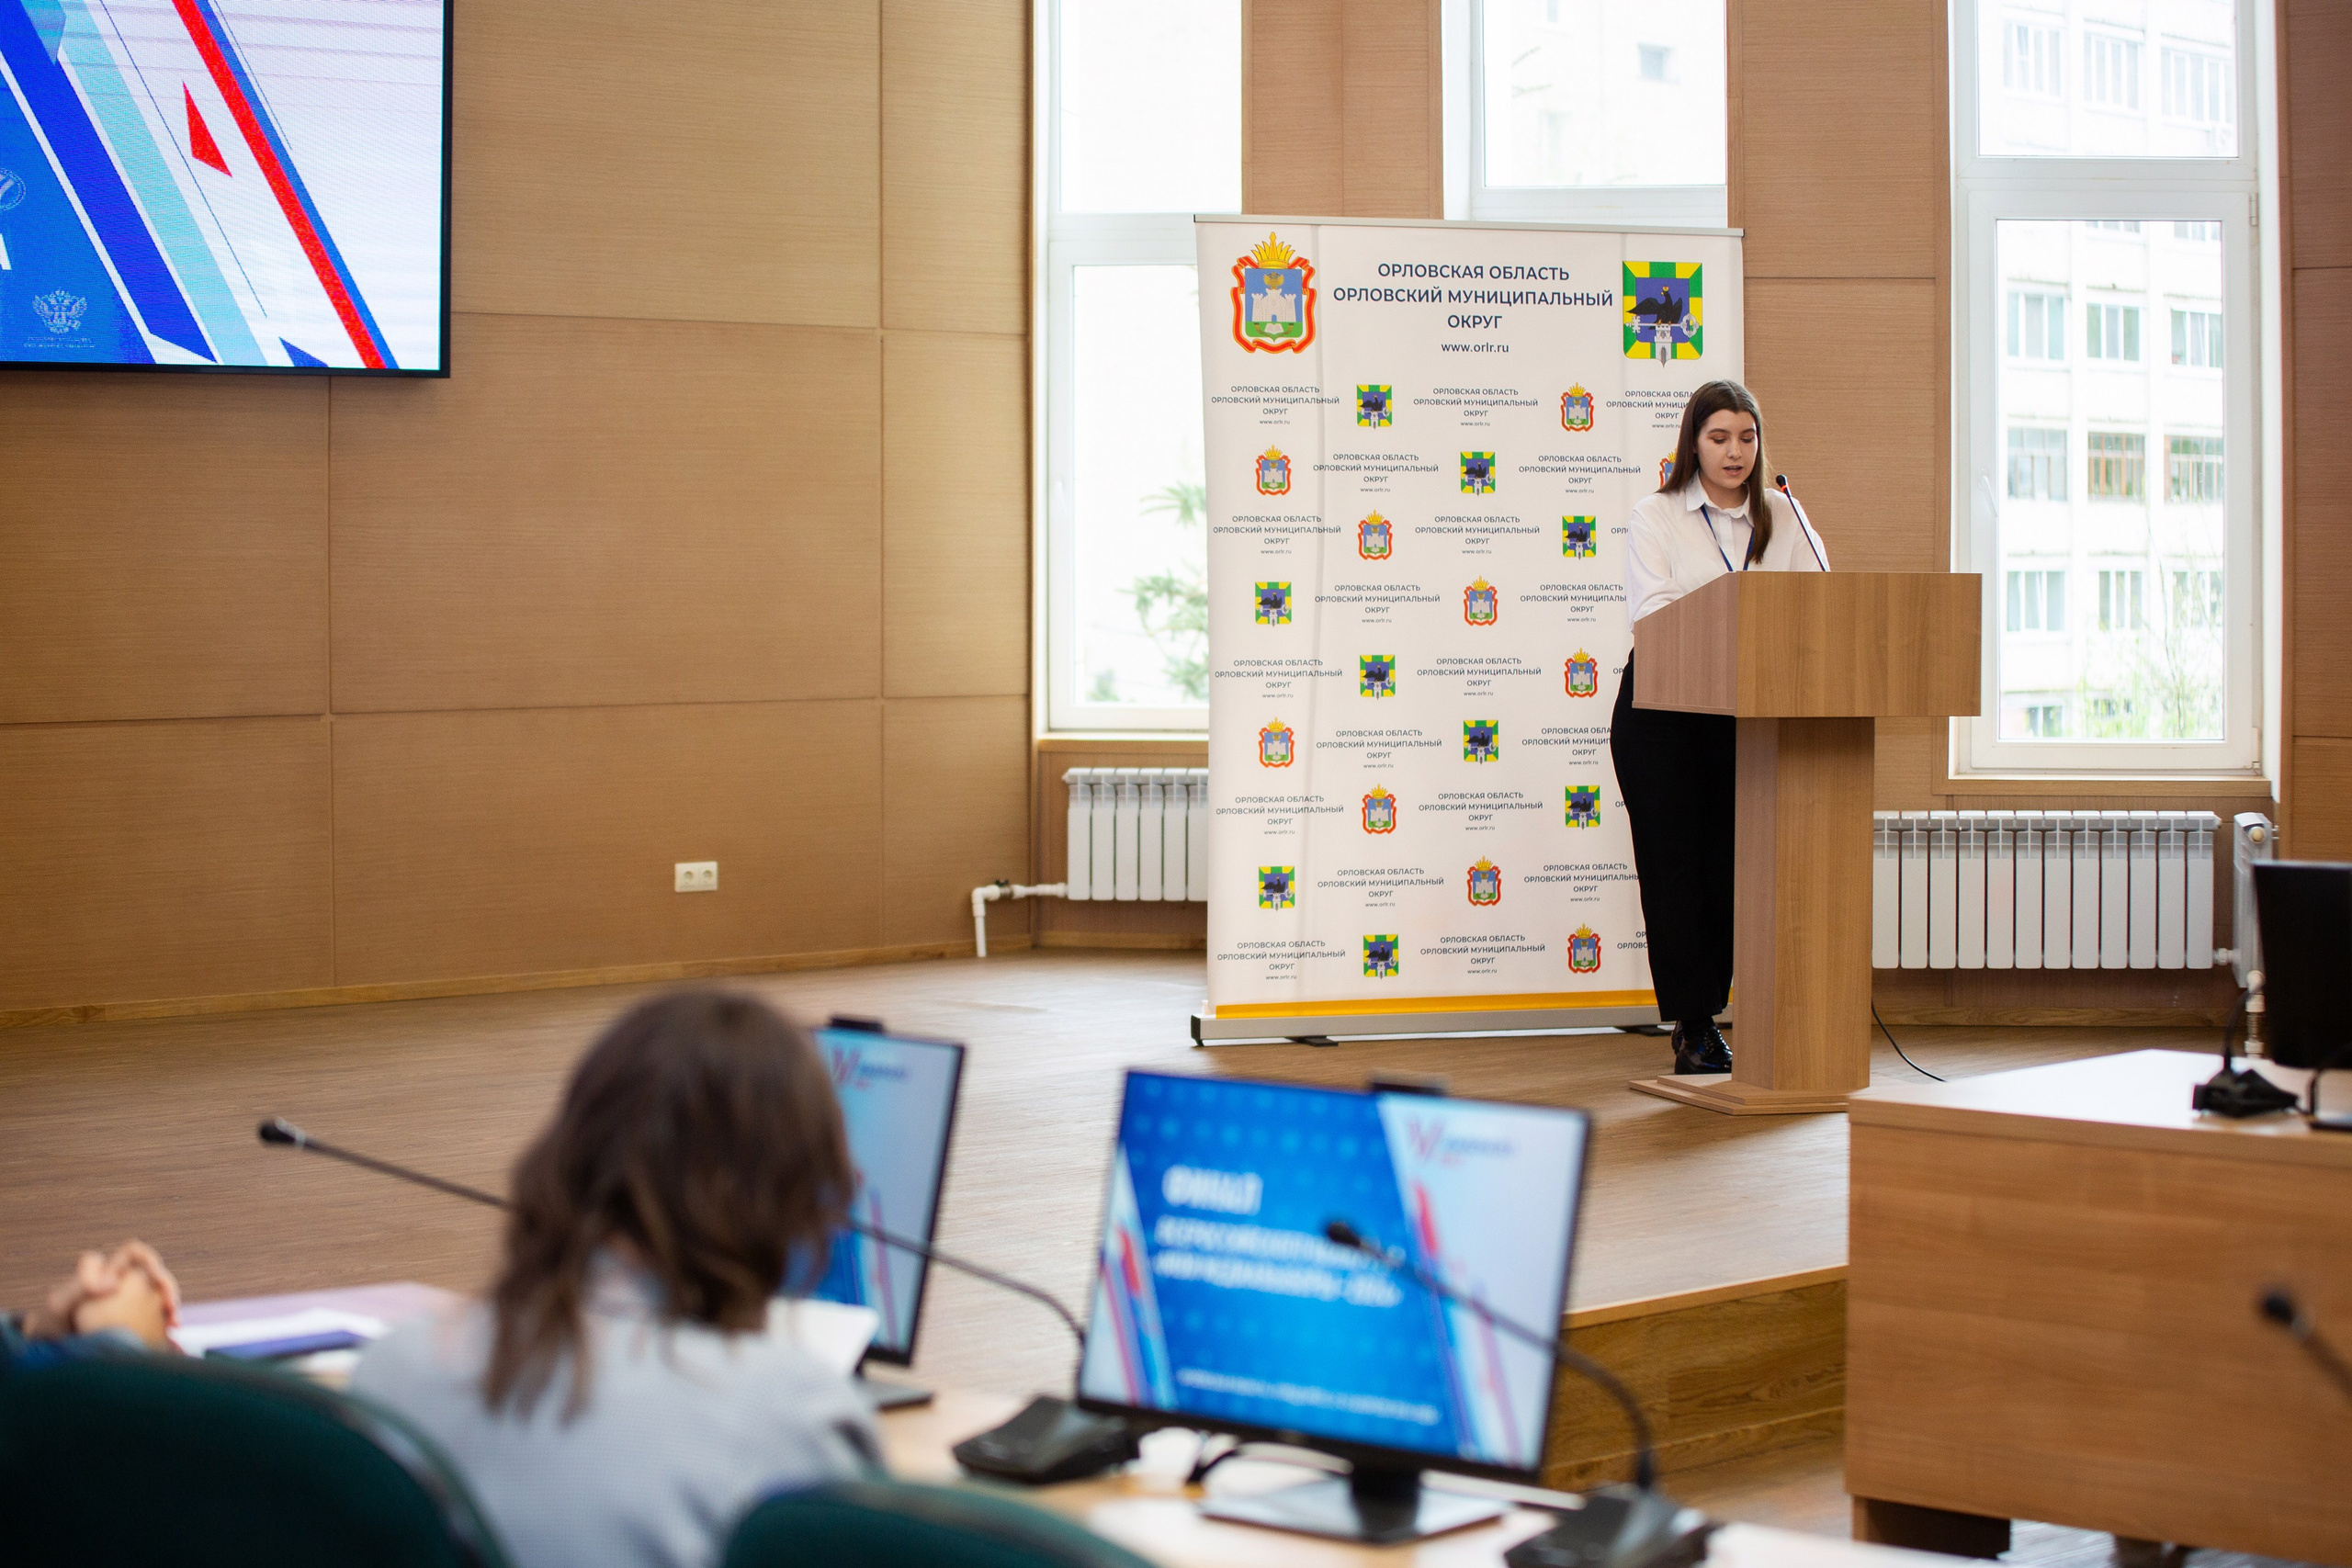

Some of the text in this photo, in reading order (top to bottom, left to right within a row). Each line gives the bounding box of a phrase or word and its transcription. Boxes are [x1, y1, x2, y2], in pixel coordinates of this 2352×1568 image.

[1378, 264, 1569, 280] ОРЛОВСКАЯ ОБЛАСТЬ
[1333, 286, 1612, 307] ОРЛОВСКИЙ МУНИЦИПАЛЬНЫЙ
[1448, 314, 1502, 329] ОКРУГ
[1441, 341, 1509, 353] www.orlr.ru
[1231, 385, 1319, 394] ОРЛОВСКАЯ ОБЛАСТЬ
[1433, 388, 1519, 396] ОРЛОВСКАЯ ОБЛАСТЬ
[1625, 389, 1671, 399] ОРЛОВСКАЯ
[1211, 395, 1340, 404] ОРЛОВСКИЙ МУНИЦИПАЛЬНЫЙ
[1413, 397, 1538, 407] ОРЛОВСКИЙ МУНИЦИПАЛЬНЫЙ
[1606, 400, 1653, 408] ОРЛОВСКИЙ
[1262, 407, 1289, 415] ОКРУГ
[1464, 409, 1489, 418] ОКРУГ
[1655, 412, 1679, 420] ОКРУГ
[1333, 453, 1419, 462] ОРЛОВСКАЯ ОБЛАСТЬ
[1538, 455, 1622, 463] ОРЛОВСКАЯ ОБЛАСТЬ
[1313, 463, 1438, 472] ОРЛОВСКИЙ МУНИЦИПАЛЬНЫЙ
[1519, 465, 1641, 474] ОРЛОВСКИЙ МУНИЦИПАЛЬНЫЙ
[1363, 475, 1389, 483] ОКРУГ
[1568, 476, 1593, 485] ОКРУГ
[1283, 515, 1321, 524] ОБЛАСТЬ
[1435, 515, 1520, 524] ОРЛОВСКАЯ ОБЛАСТЬ
[1213, 525, 1340, 534] ОРЛОВСКИЙ МУНИЦИПАЛЬНЫЙ
[1415, 525, 1540, 535] ОРЛОВСКИЙ МУНИЦИПАЛЬНЫЙ
[1465, 537, 1490, 546] ОКРУГ
[1335, 584, 1420, 592] ОРЛОВСКАЯ ОБЛАСТЬ
[1540, 583, 1623, 592] ОРЛОВСКАЯ ОБЛАСТЬ
[1315, 594, 1440, 603] ОРЛОВСКИЙ МУНИЦИПАЛЬНЫЙ
[1521, 593, 1568, 602] ОРЛОВСКИЙ
[1570, 605, 1595, 614] ОКРУГ
[1234, 659, 1323, 668] ОРЛОВСКАЯ ОБЛАСТЬ
[1436, 657, 1521, 666] ОРЛОВСКАЯ ОБЛАСТЬ
[1215, 669, 1342, 678] ОРЛОВСКИЙ МУНИЦИПАЛЬНЫЙ
[1417, 667, 1541, 676] ОРЛОВСКИЙ МУНИЦИПАЛЬНЫЙ
[1266, 681, 1293, 689] ОКРУГ
[1467, 679, 1492, 687] ОКРУГ
[1336, 728, 1422, 738] ОРЛОВСКАЯ ОБЛАСТЬ
[1542, 727, 1589, 735] ОРЛОВСКАЯ
[1317, 739, 1442, 749] ОРЛОВСКИЙ МУНИЦИПАЛЬНЫЙ
[1522, 737, 1570, 745] ОРЛОВСКИЙ
[1367, 751, 1393, 760] ОКРУГ
[1572, 748, 1598, 756] ОКРУГ
[1236, 795, 1324, 804] ОРЛОВСКАЯ ОБЛАСТЬ
[1438, 791, 1523, 801] ОРЛОВСКАЯ ОБЛАСТЬ
[1216, 804, 1343, 815] ОРЛОВСКИЙ МУНИЦИПАЛЬНЫЙ
[1419, 801, 1543, 811] ОРЛОВСКИЙ МУНИЦИПАЛЬНЫЙ
[1267, 818, 1294, 826] ОКРУГ
[1468, 813, 1494, 822] ОКРУГ
[1338, 867, 1424, 877] ОРЛОВСКАЯ ОБЛАСТЬ
[1544, 863, 1627, 873] ОРЛОВСКАЯ ОБЛАСТЬ
[1317, 877, 1443, 887] ОРЛОВСКИЙ МУНИЦИПАЛЬНЫЙ
[1524, 874, 1571, 883] ОРЛОВСКИЙ
[1573, 885, 1599, 893] ОКРУГ
[1369, 890, 1394, 898] ОКРУГ
[1441, 934, 1525, 944] ОРЛОВСКАЯ ОБЛАСТЬ
[1238, 940, 1325, 950] ОРЛОВСКАЯ ОБЛАСТЬ
[1420, 943, 1545, 954] ОРЛОВСКИЙ МУНИЦИПАЛЬНЫЙ
[1217, 950, 1345, 960] ОРЛОВСКИЙ МУНИЦИПАЛЬНЫЙ
[1471, 956, 1496, 965] ОКРУГ
[1269, 963, 1295, 971] ОКРУГ
